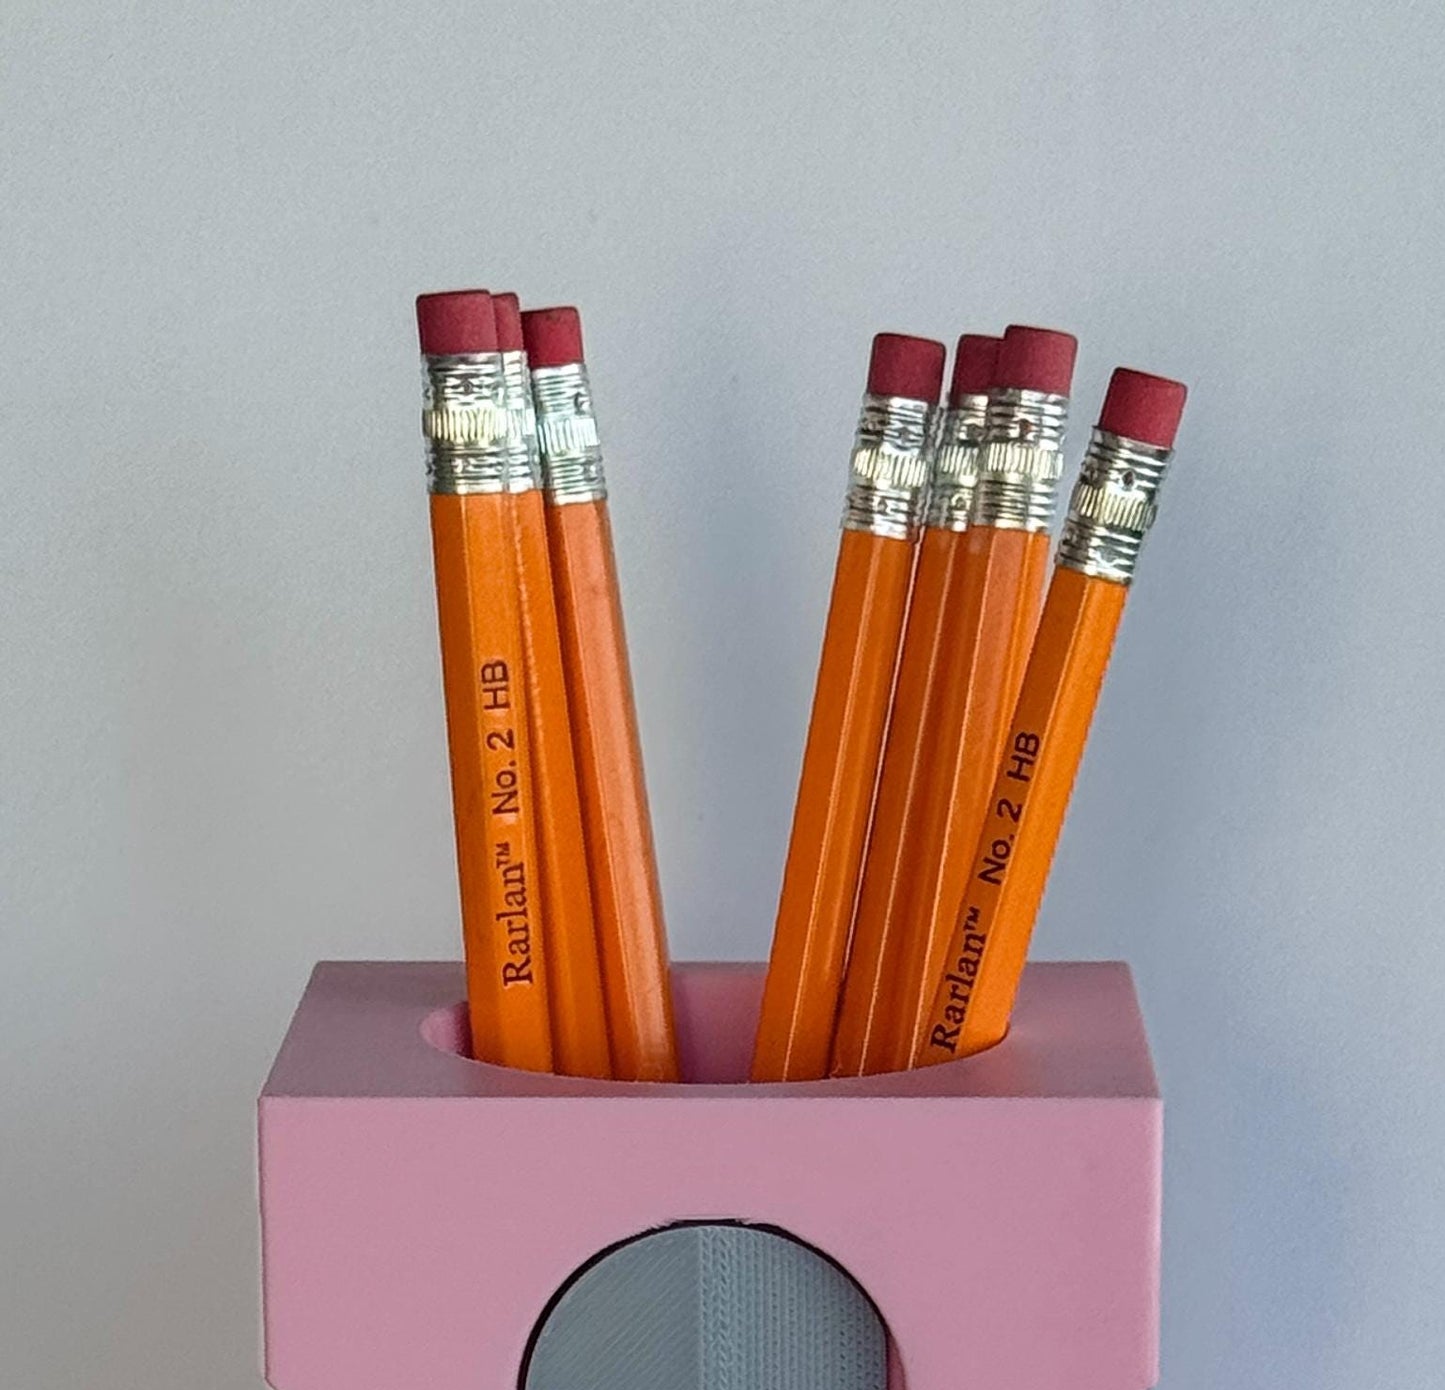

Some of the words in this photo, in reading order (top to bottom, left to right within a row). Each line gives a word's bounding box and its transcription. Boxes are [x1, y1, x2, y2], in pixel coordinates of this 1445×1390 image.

[481, 658, 510, 711] HB
[486, 728, 515, 751] 2
[1006, 731, 1040, 782] HB
[491, 759, 520, 815] No.
[996, 798, 1022, 823] 2
[978, 834, 1015, 885] No.
